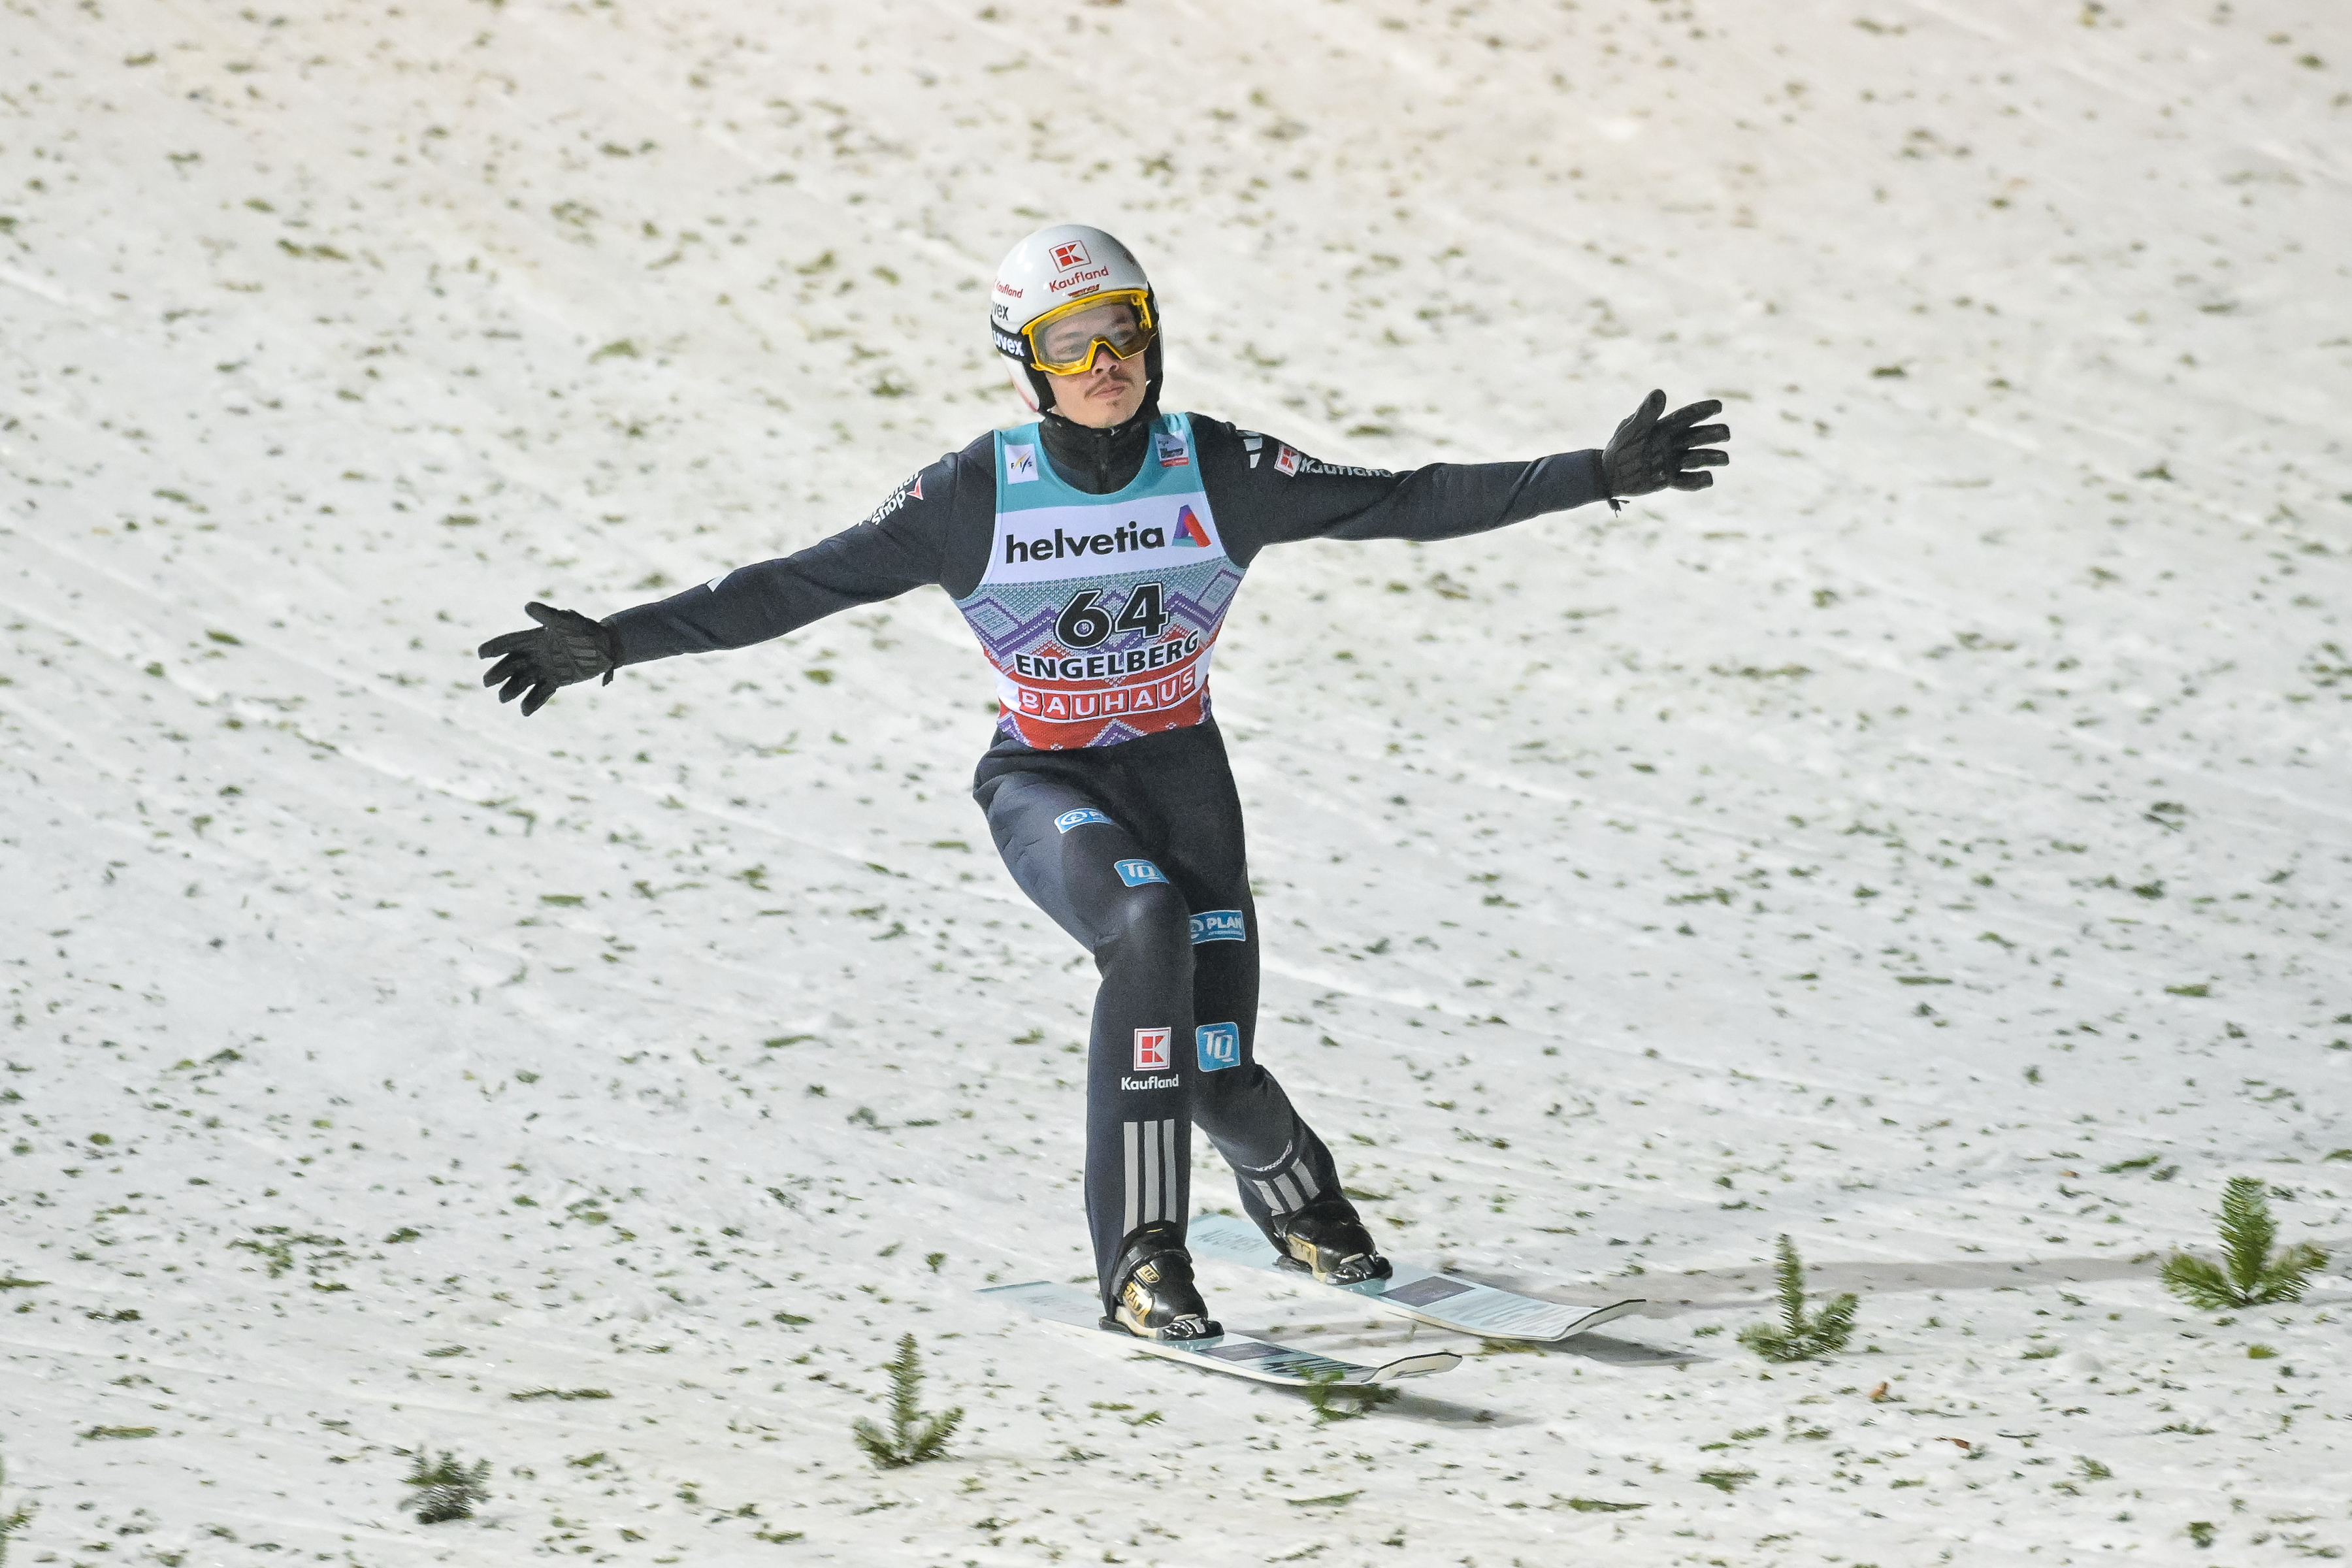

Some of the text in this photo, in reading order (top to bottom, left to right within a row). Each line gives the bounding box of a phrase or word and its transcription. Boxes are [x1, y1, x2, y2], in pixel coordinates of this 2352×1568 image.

[1049, 266, 1109, 292] Kaufland
[992, 301, 1009, 321] vex
[993, 330, 1024, 357] uvex
[1005, 521, 1165, 564] helvetia
[1054, 581, 1171, 650] 64
[1015, 630, 1198, 680] ENGELBERG
[1021, 674, 1194, 717] BAUHAUS
[1121, 1074, 1179, 1090] Kaufland
